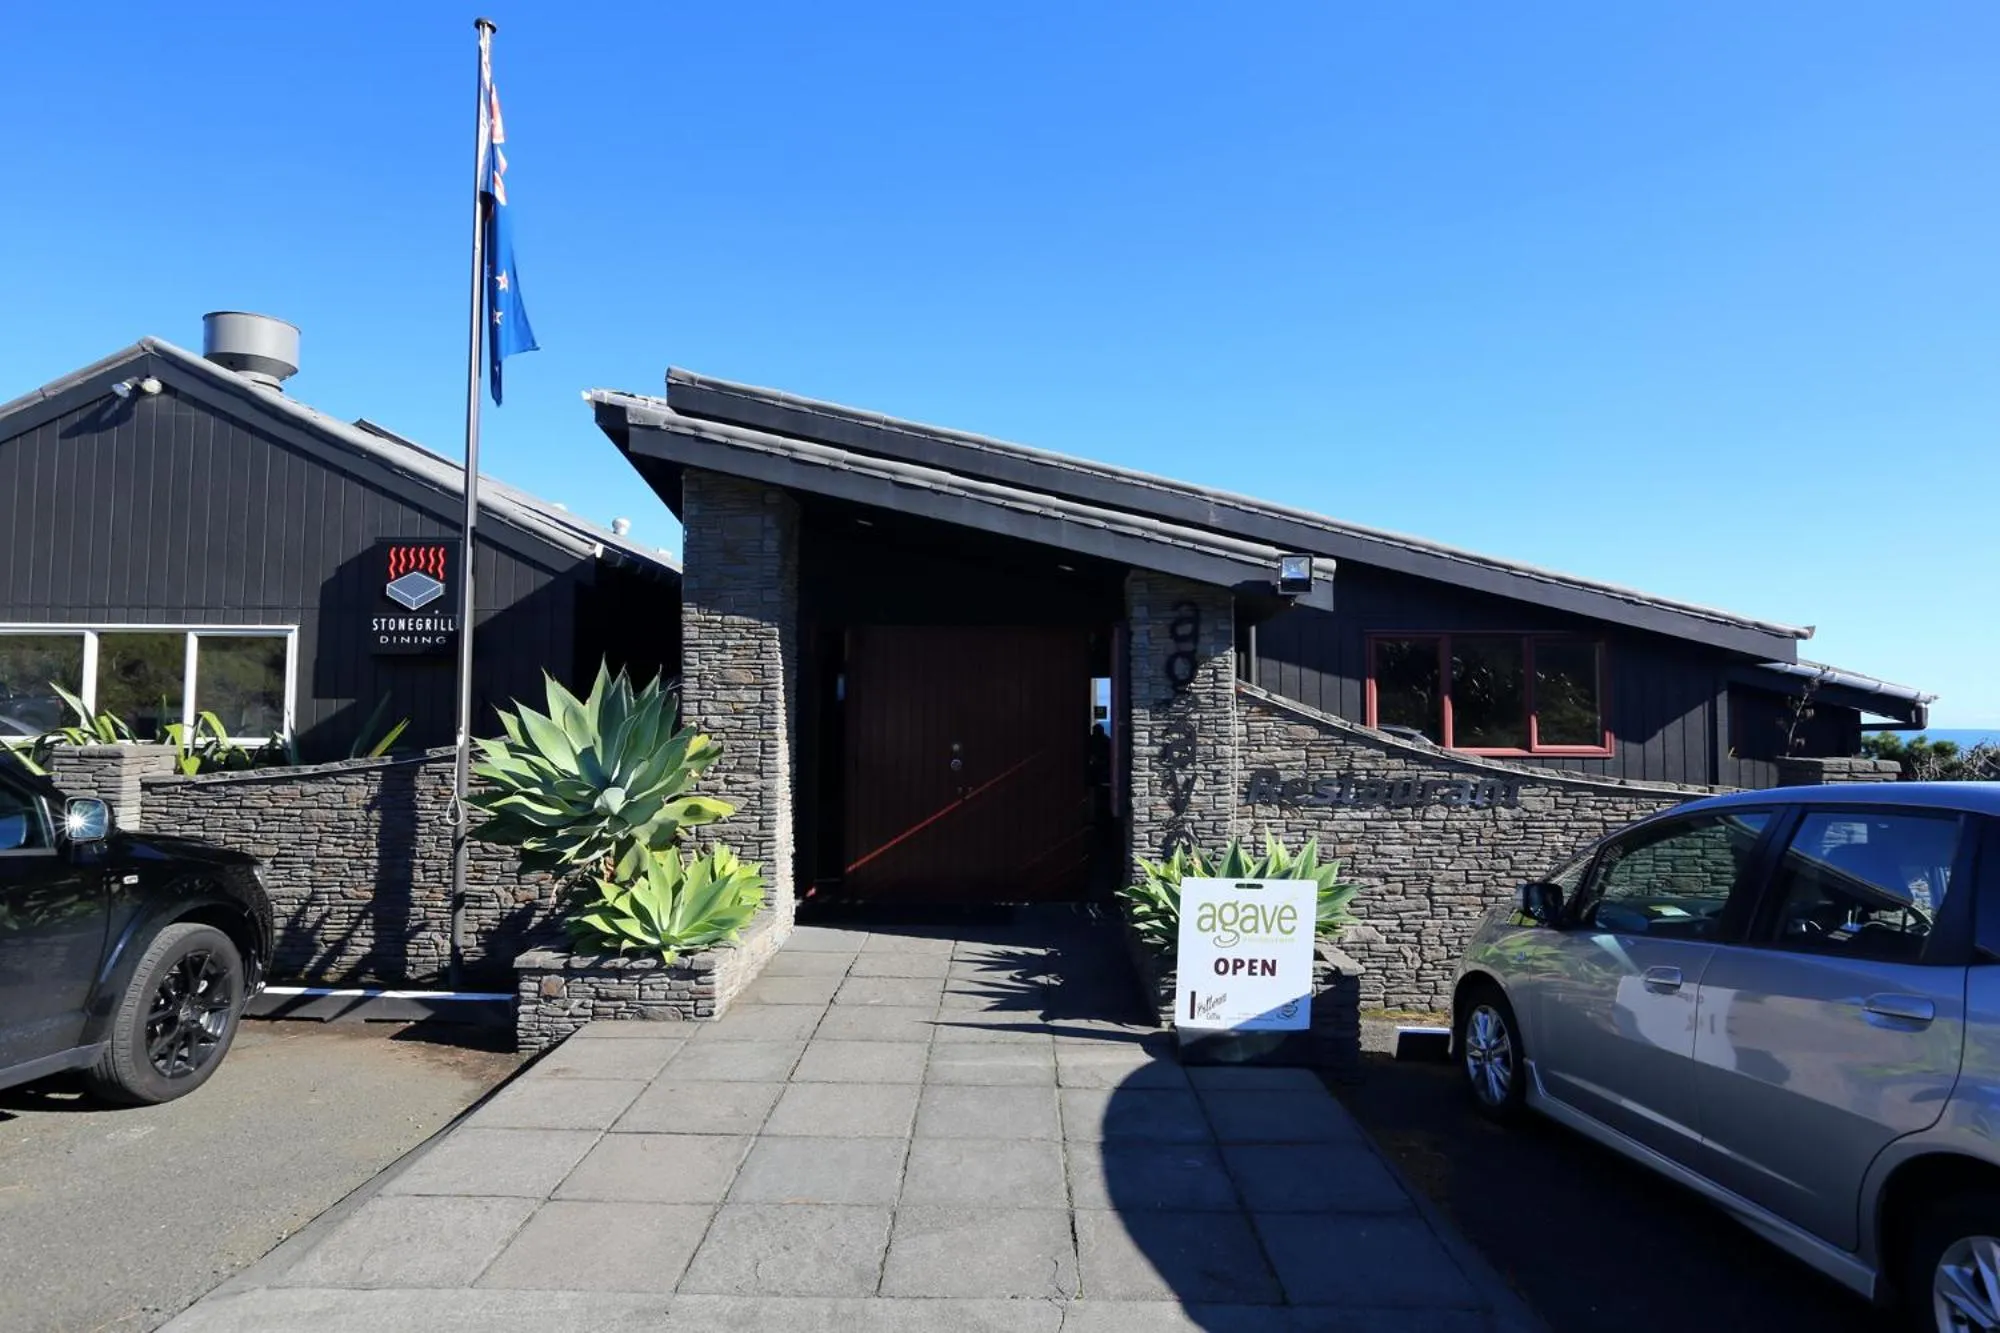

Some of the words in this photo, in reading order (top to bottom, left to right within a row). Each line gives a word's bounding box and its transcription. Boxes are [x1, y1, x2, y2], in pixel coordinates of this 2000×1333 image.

[372, 618, 454, 631] STONEGRILL
[379, 635, 446, 644] DINING
[1248, 769, 1520, 805] Restaurant
[1196, 899, 1298, 948] agave
[1213, 957, 1277, 977] OPEN
